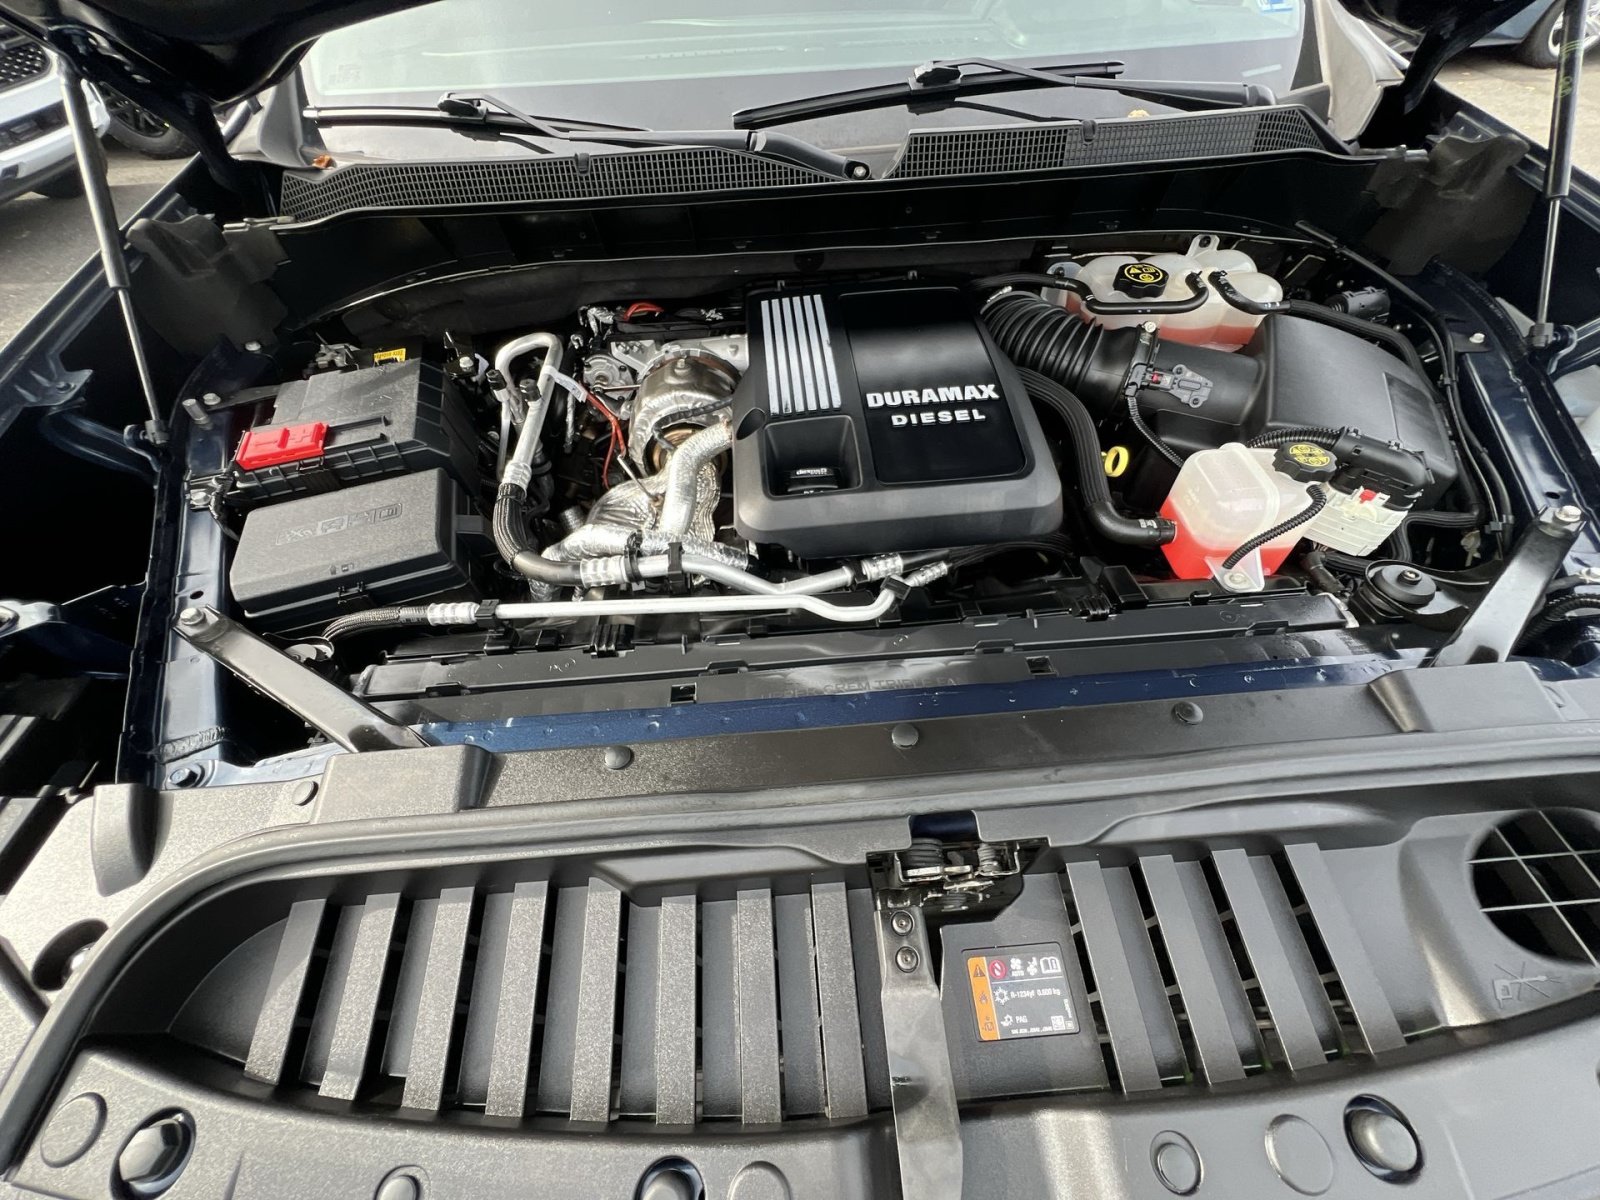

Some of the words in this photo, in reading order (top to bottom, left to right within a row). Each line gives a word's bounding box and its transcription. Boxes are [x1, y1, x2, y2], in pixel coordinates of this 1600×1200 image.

[866, 384, 1000, 408] DURAMAX
[891, 409, 986, 426] DIESEL
[1015, 1015, 1028, 1024] PAG
